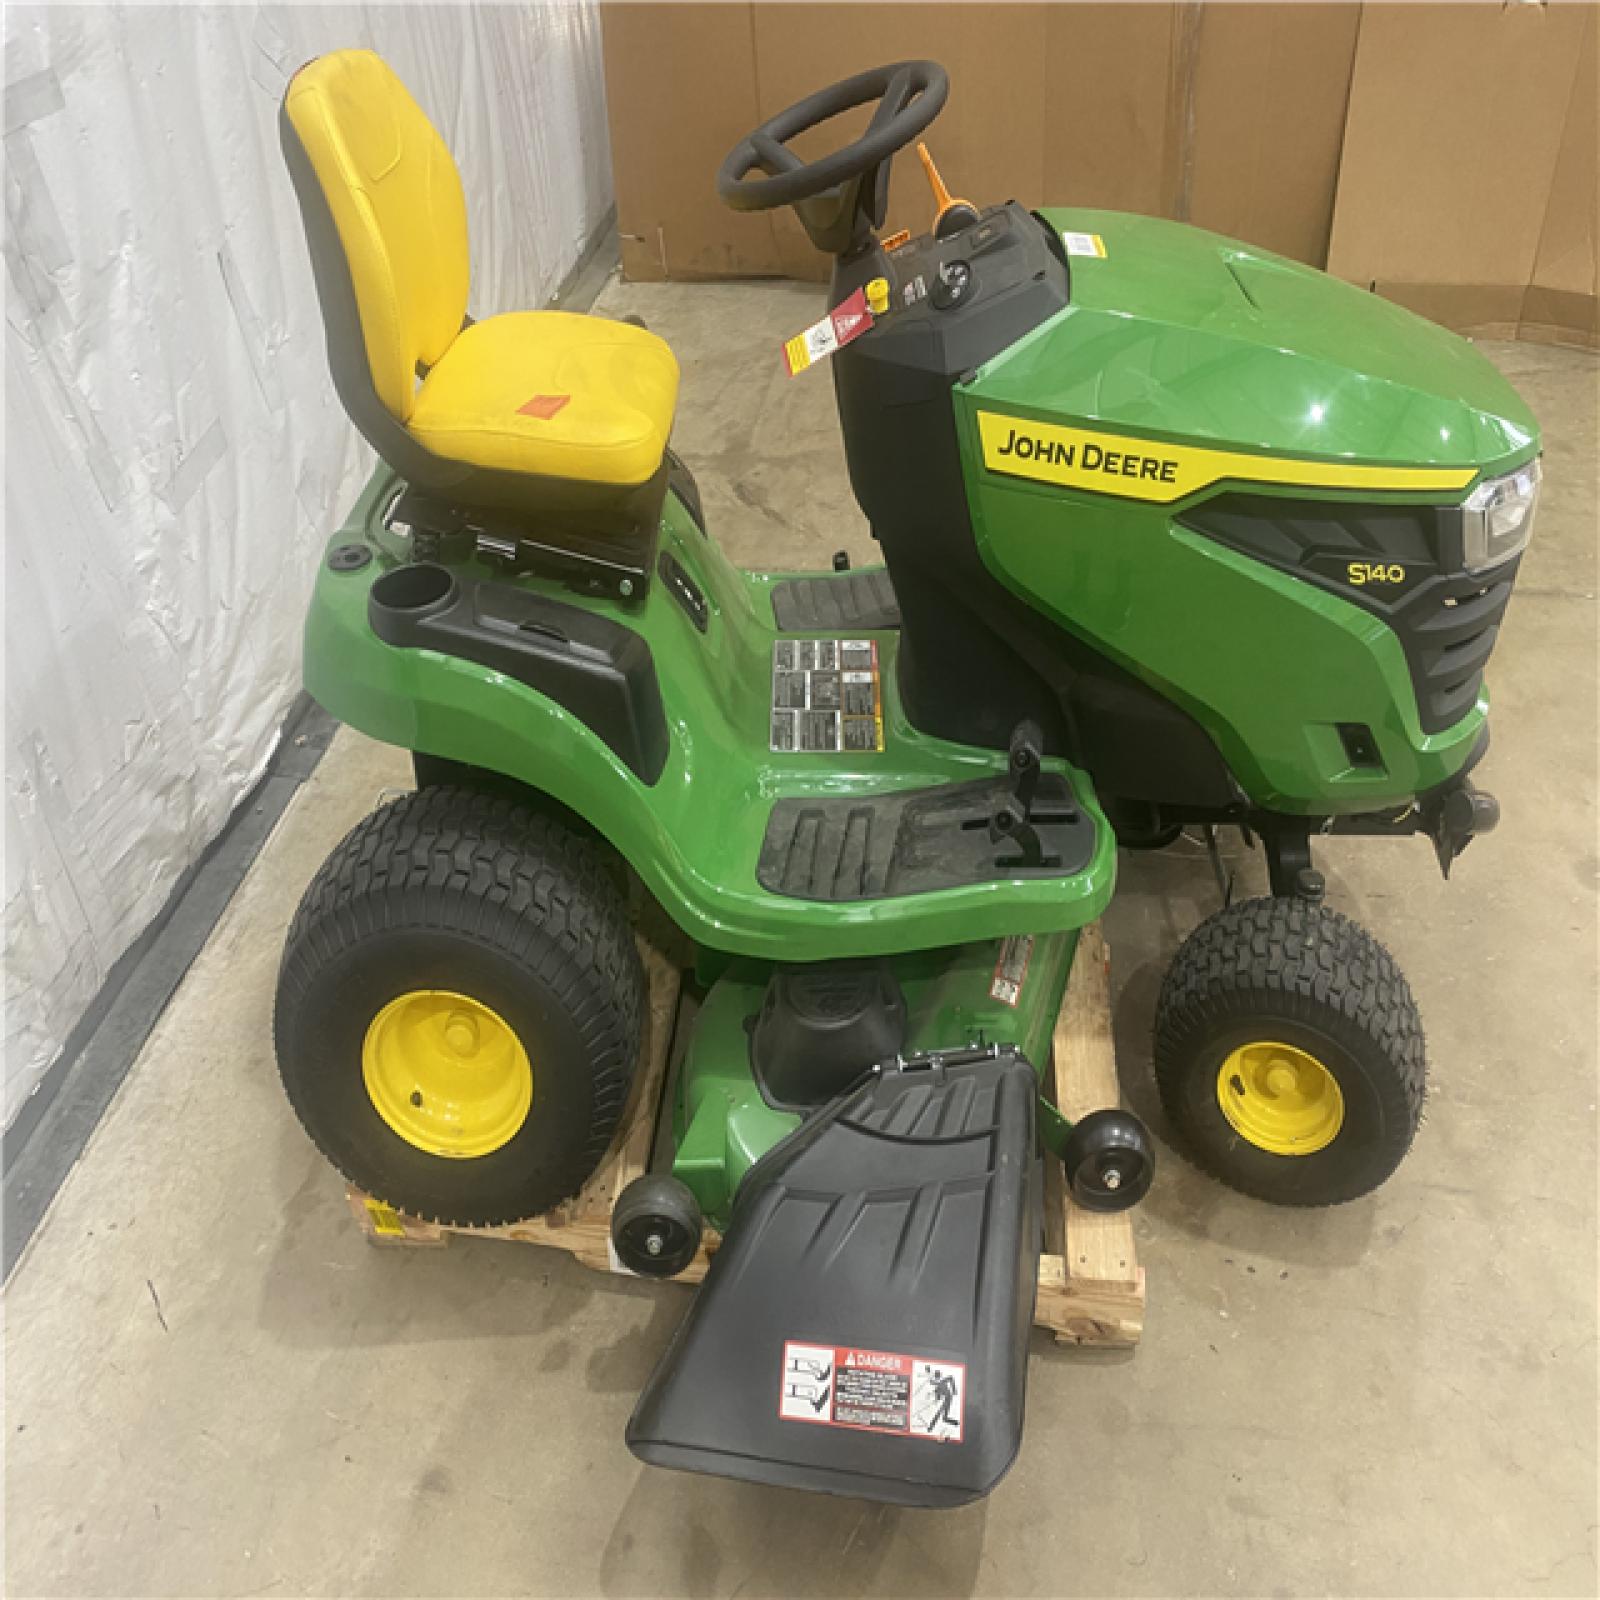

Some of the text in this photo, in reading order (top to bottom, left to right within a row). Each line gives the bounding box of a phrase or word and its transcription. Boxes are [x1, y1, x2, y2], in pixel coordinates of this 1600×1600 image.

[997, 429, 1179, 483] JOHN DEERE
[1347, 561, 1406, 586] S140
